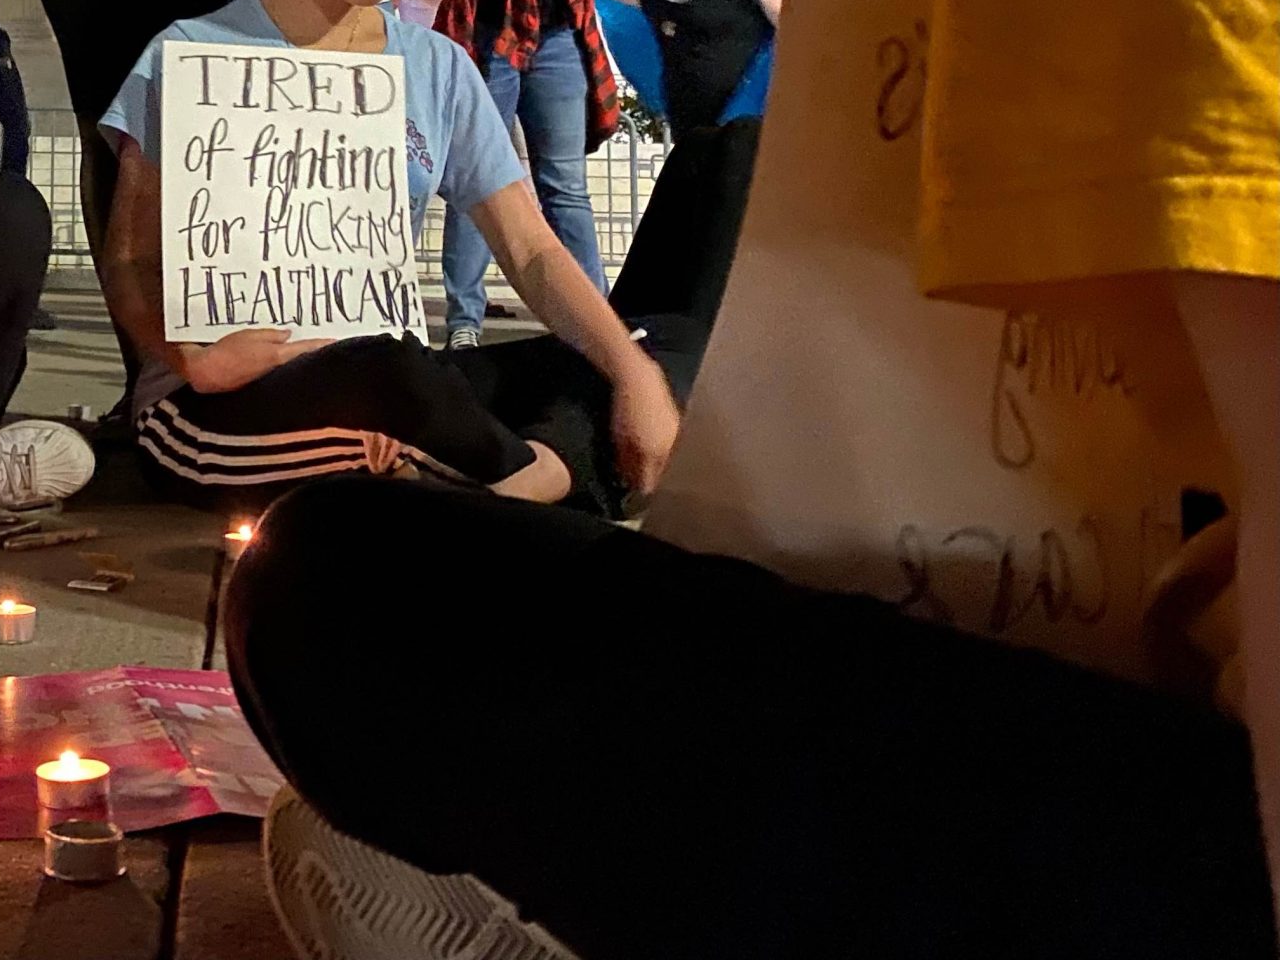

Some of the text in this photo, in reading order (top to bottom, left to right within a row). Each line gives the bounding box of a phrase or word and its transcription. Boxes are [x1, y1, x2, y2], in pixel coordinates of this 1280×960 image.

[179, 54, 396, 118] TIRED
[185, 117, 397, 218] of fighting
[178, 187, 246, 262] for
[174, 262, 423, 331] HEALTHCARE
